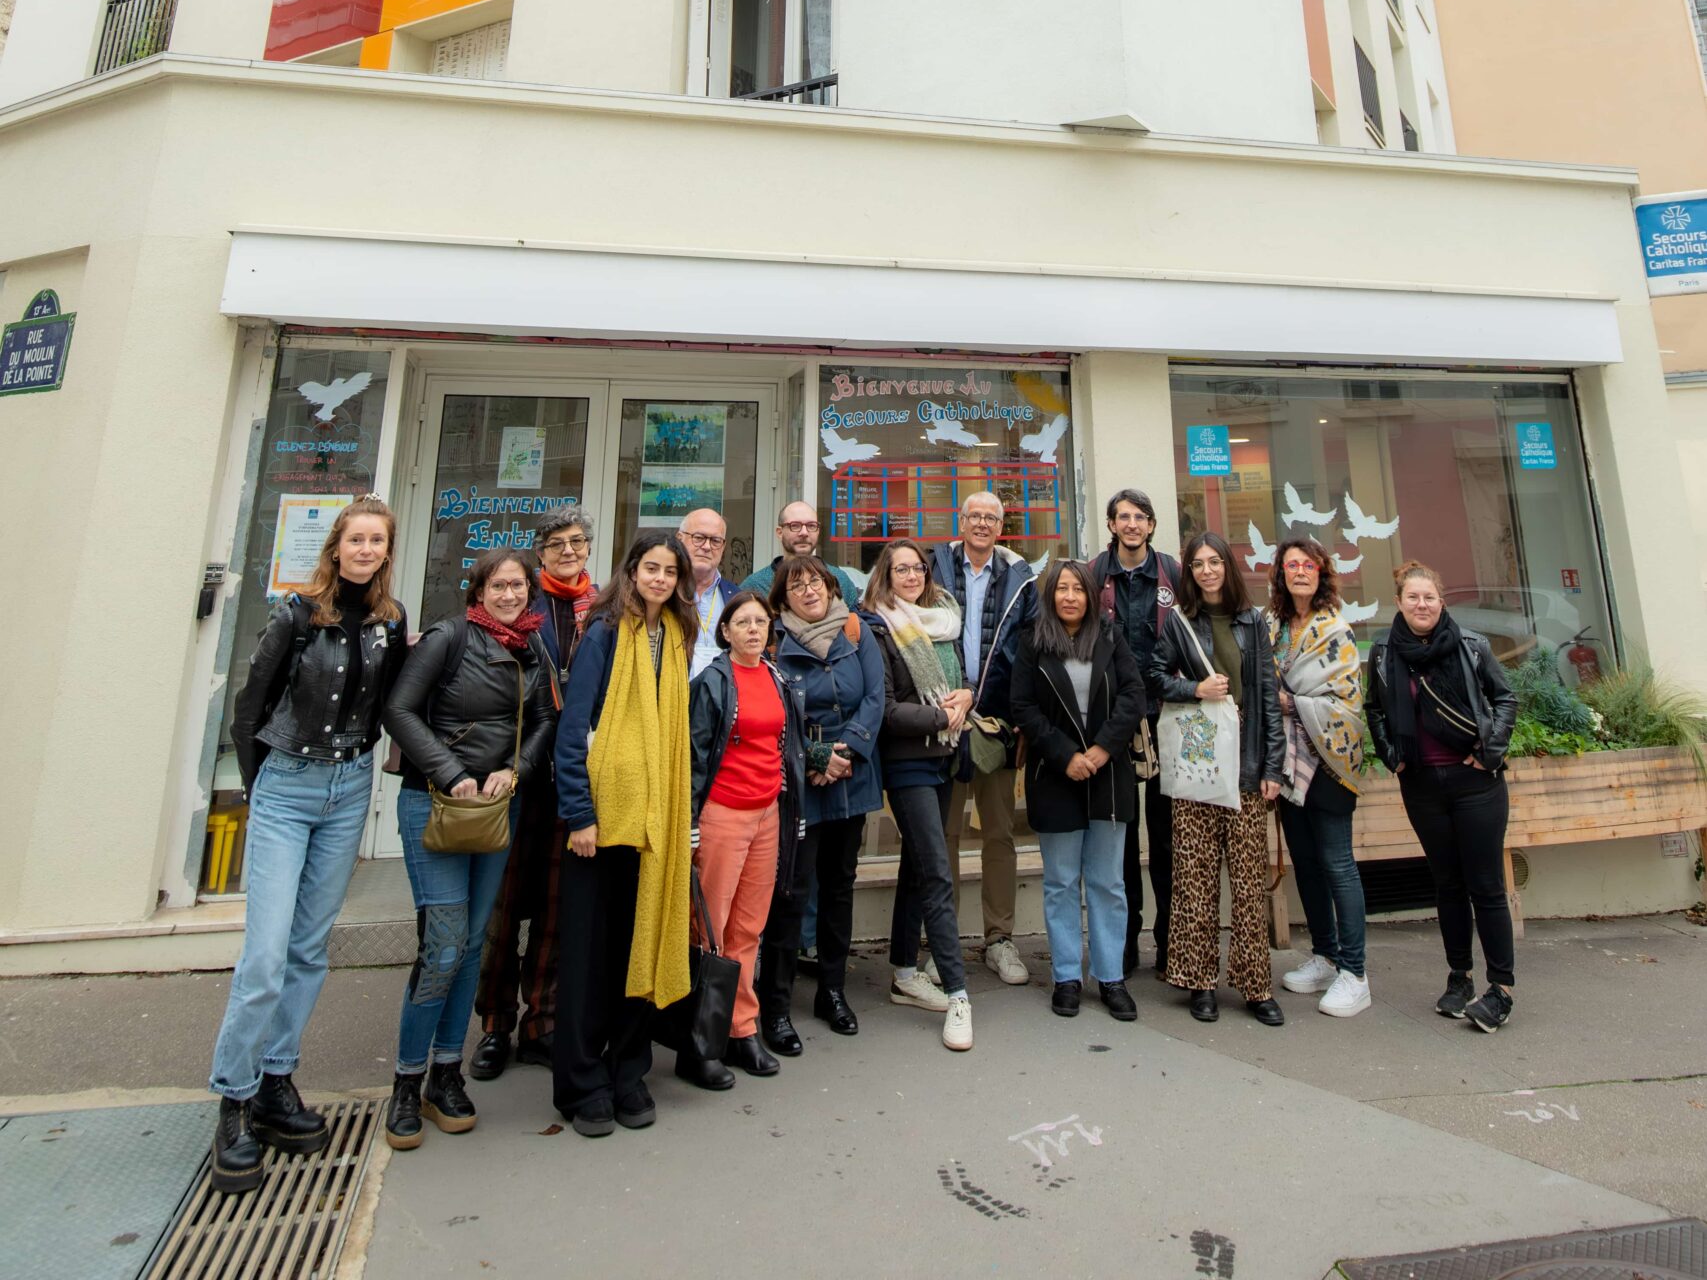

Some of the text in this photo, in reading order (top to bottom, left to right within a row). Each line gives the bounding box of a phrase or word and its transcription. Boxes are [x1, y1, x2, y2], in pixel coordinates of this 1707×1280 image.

[1652, 231, 1707, 245] Secours
[1649, 259, 1685, 270] Caritas
[27, 329, 44, 345] RUE
[9, 346, 55, 366] DU MOULIN
[2, 365, 54, 385] DE LA POINTE
[1194, 446, 1223, 454] Secours
[1190, 454, 1228, 463] Catholique
